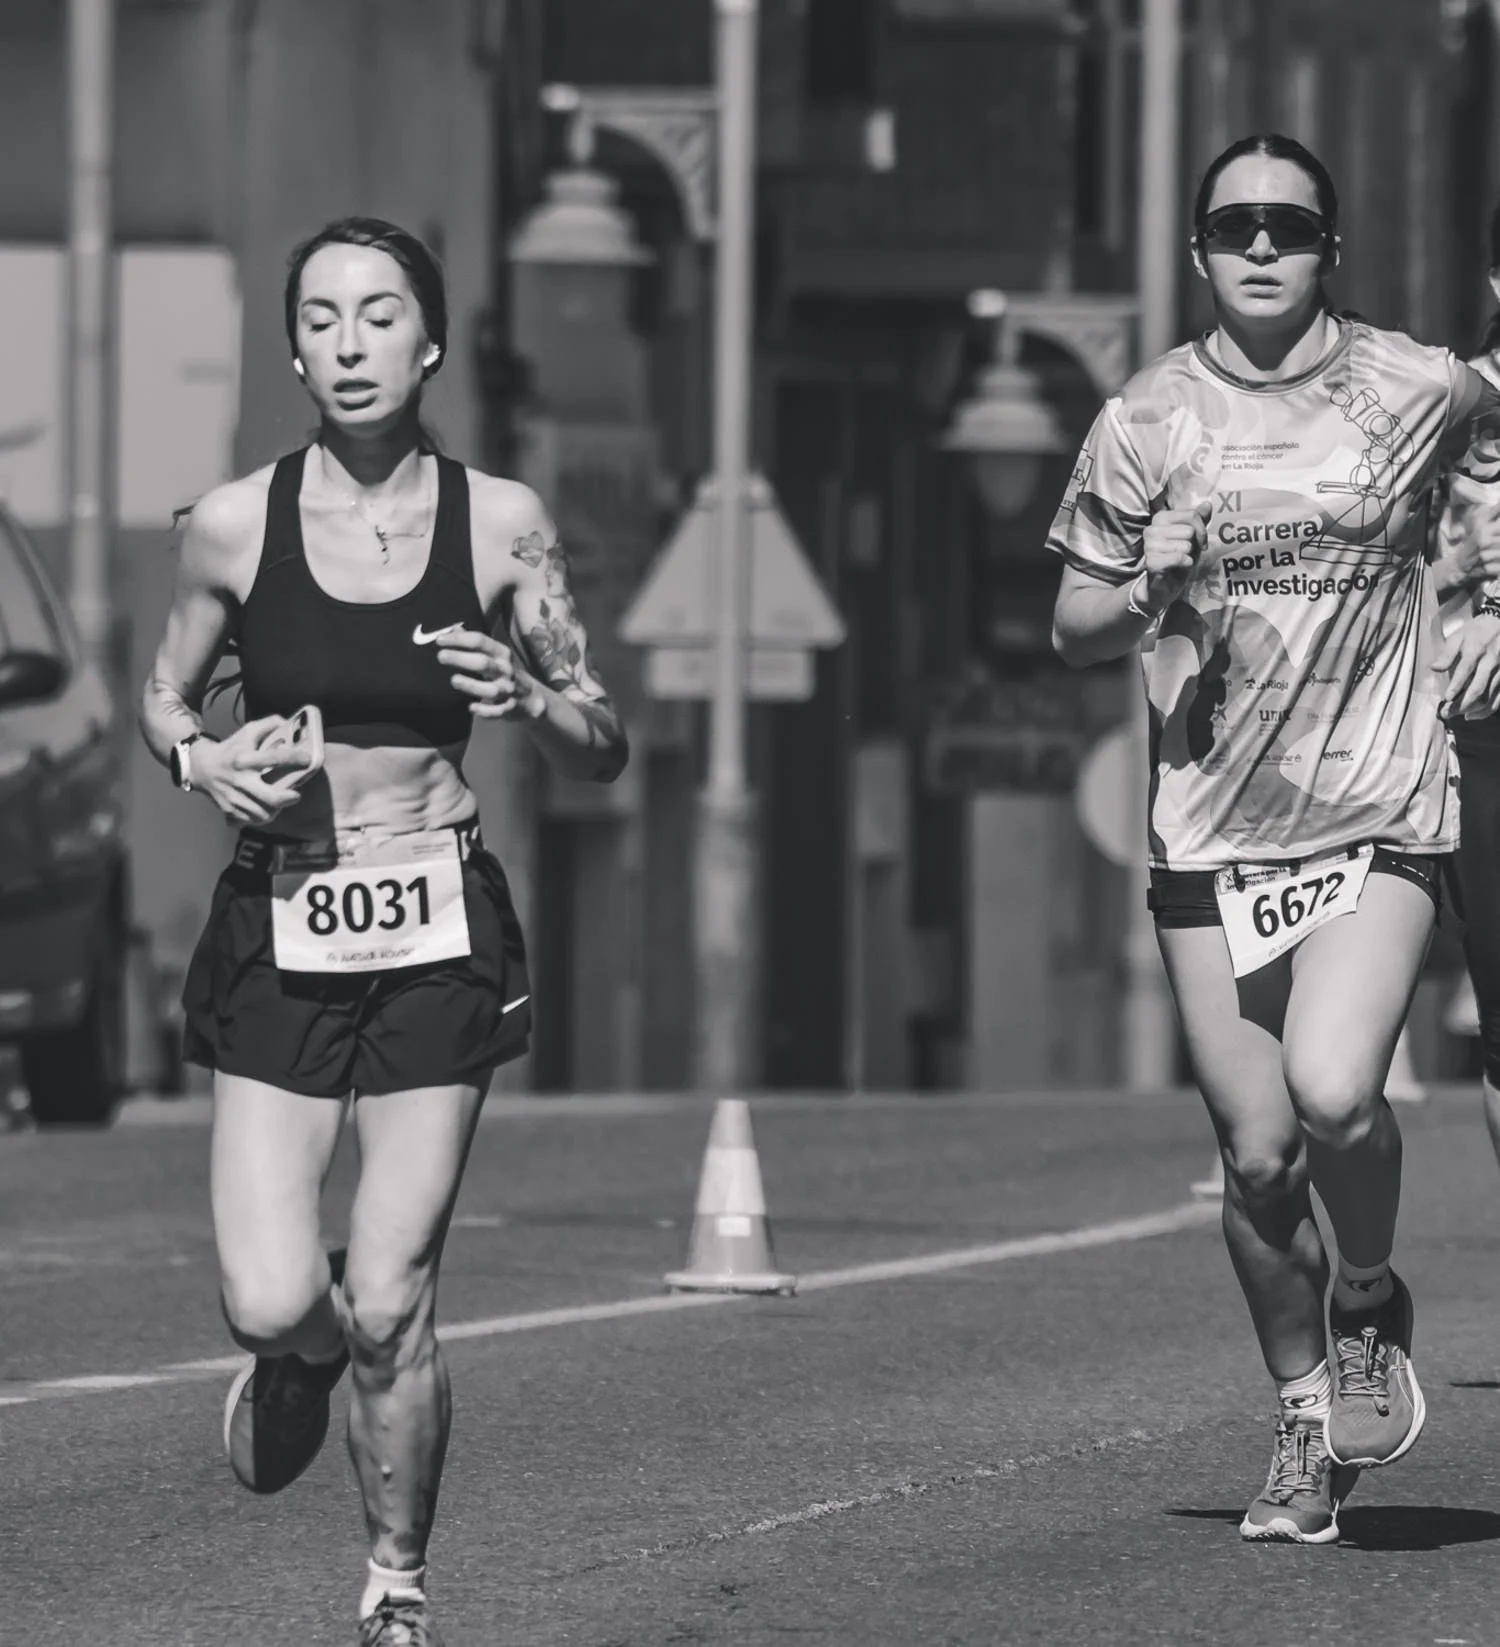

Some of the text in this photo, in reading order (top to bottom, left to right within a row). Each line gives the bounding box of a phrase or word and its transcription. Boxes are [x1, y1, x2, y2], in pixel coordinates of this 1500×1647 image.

[1217, 490, 1242, 514] XI
[1218, 519, 1319, 545] Carrera
[1222, 548, 1296, 578] por la
[1226, 568, 1380, 602] investigacón
[306, 875, 430, 936] 8031
[1252, 871, 1346, 939] 6672
